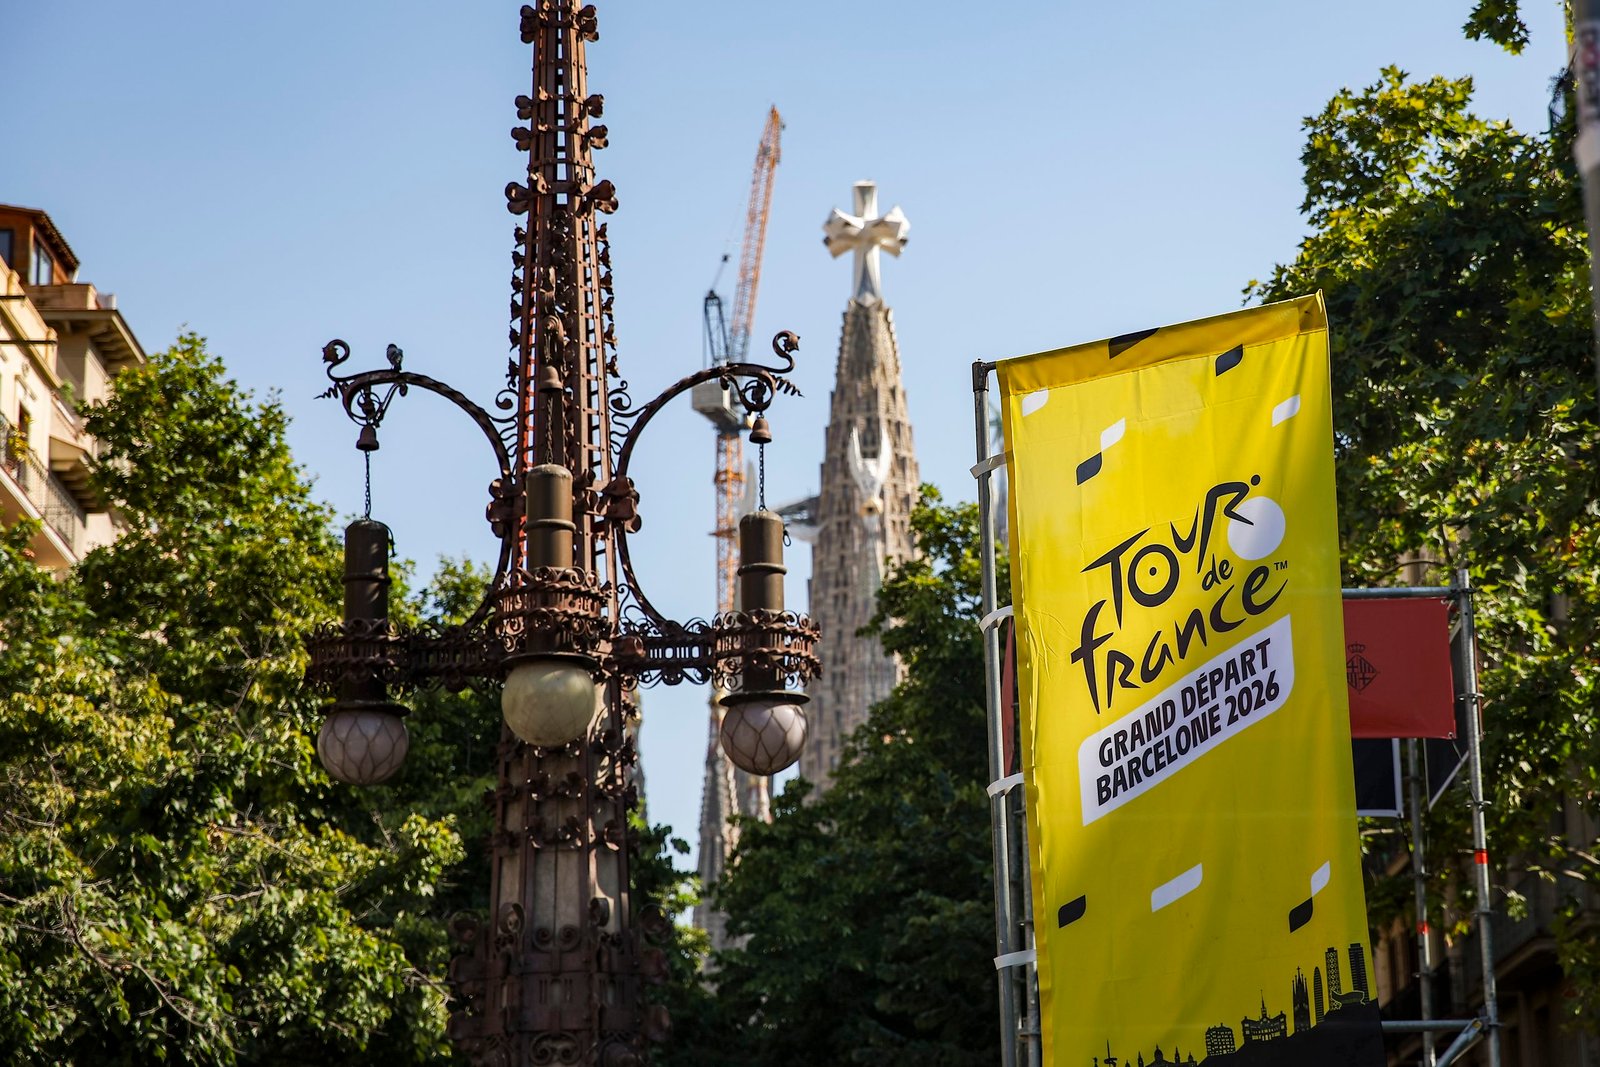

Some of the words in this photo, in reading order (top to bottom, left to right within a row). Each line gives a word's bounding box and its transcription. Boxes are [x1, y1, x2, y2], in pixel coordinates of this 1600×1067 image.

[1202, 553, 1234, 591] de
[1096, 704, 1222, 806] BARCELONE
[1225, 670, 1280, 726] 2026
[1099, 699, 1176, 767] GRAND
[1181, 637, 1271, 718] DÉPART
